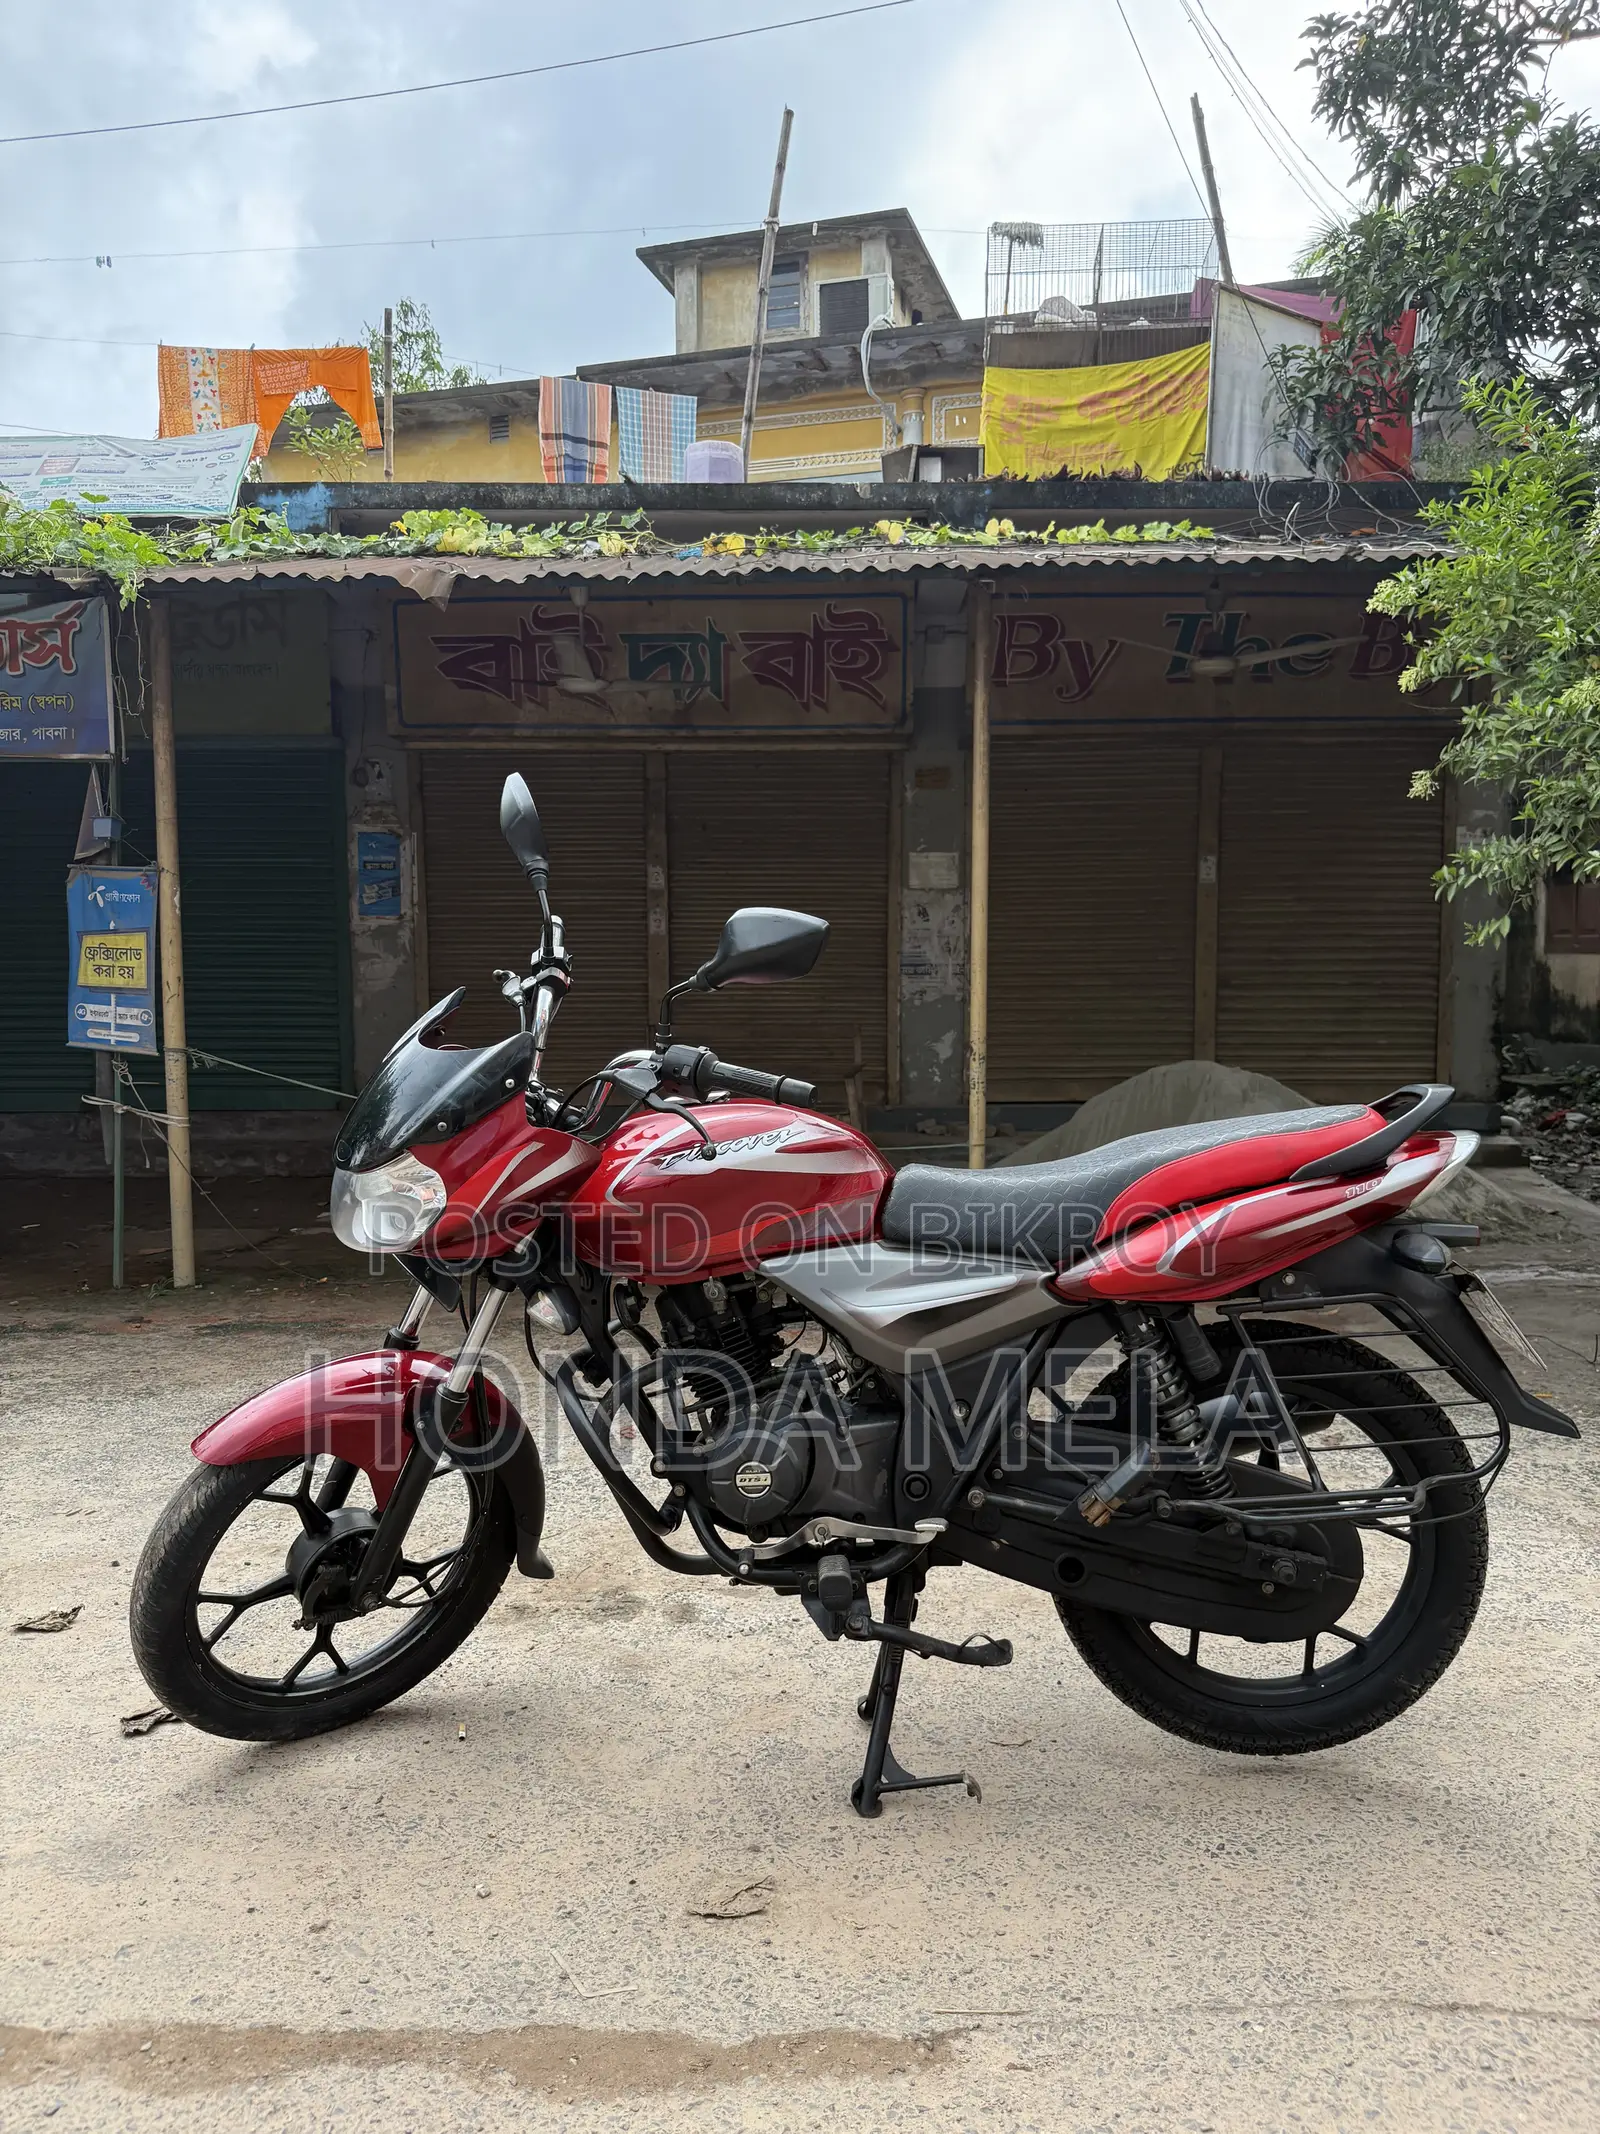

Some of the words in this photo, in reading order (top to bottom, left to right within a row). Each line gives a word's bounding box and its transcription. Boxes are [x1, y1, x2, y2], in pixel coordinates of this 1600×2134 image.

[0, 600, 84, 676] ার্স
[428, 604, 608, 712] বাই
[738, 602, 893, 708] বাই
[990, 612, 1121, 701] By
[1163, 611, 1336, 682] The
[0, 691, 22, 711] রিম
[93, 964, 115, 978] করা
[118, 965, 135, 979] হয়
